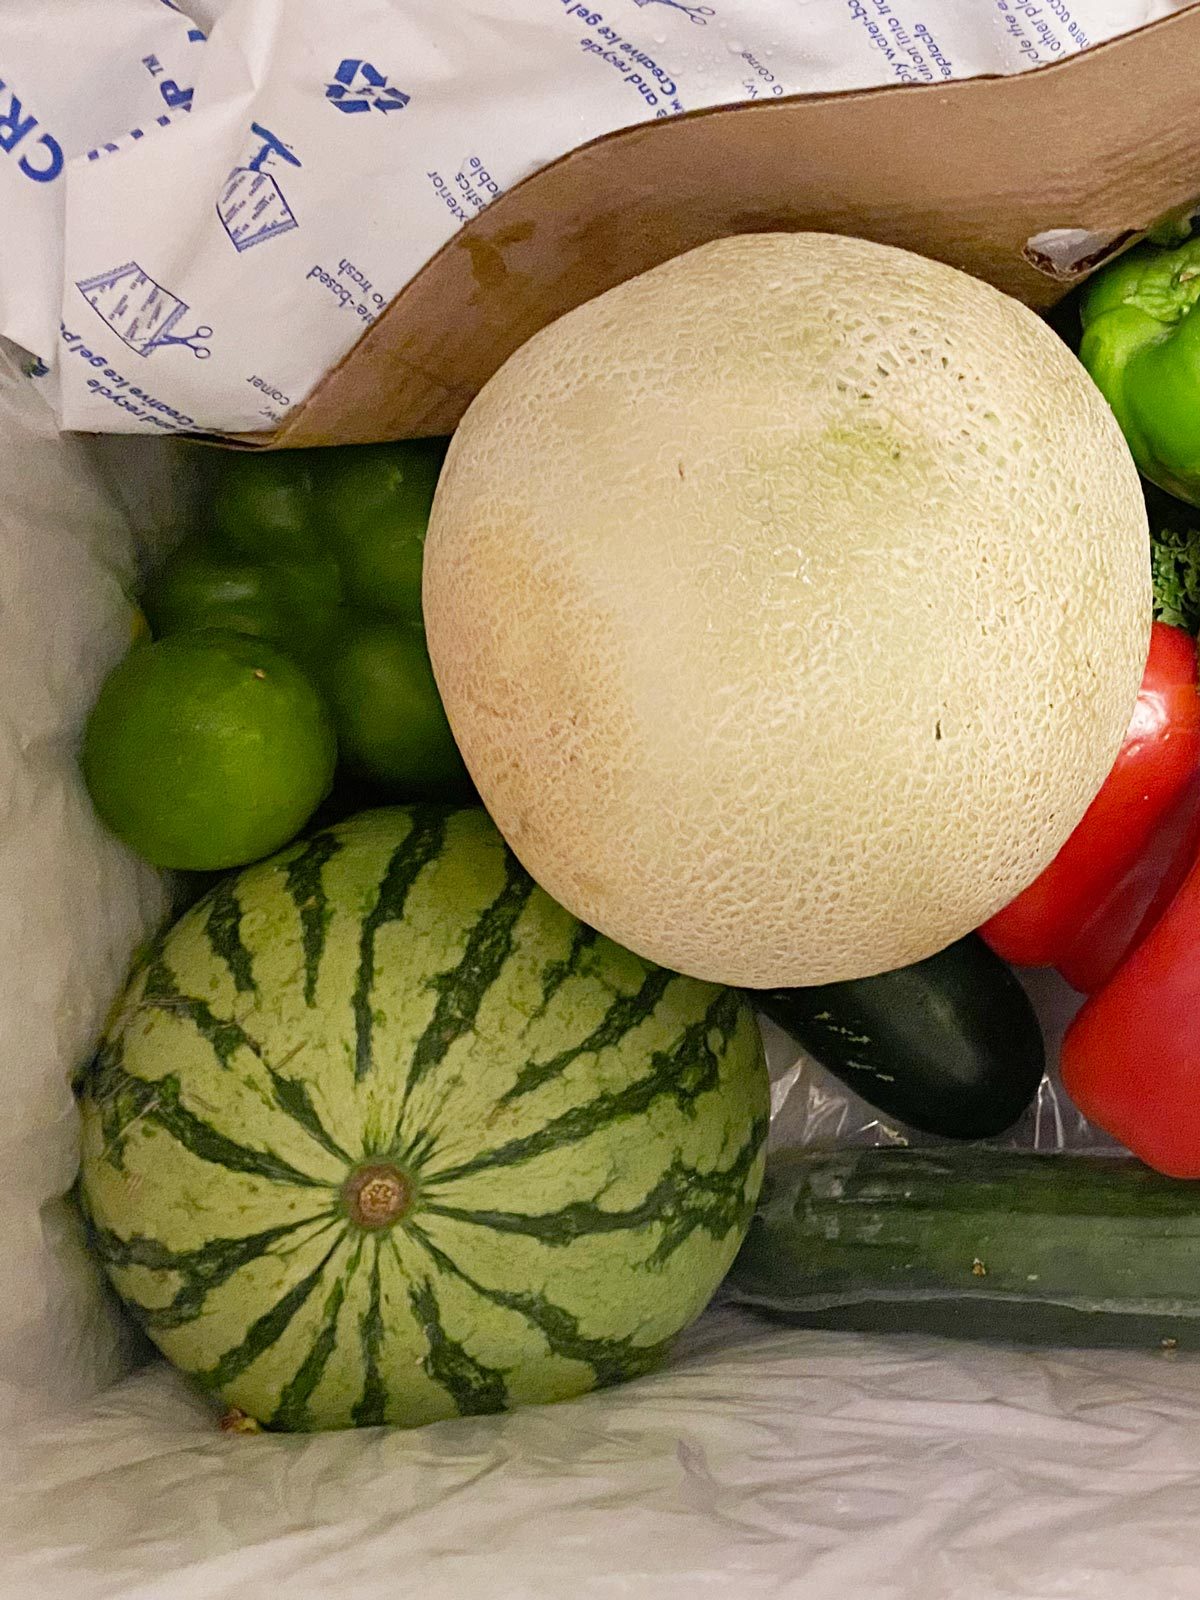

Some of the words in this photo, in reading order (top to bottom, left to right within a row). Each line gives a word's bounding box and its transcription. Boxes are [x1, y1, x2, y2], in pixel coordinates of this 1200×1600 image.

[566, 2, 603, 26] gel
[1005, 14, 1025, 37] the
[597, 25, 622, 46] Ice
[888, 17, 911, 46] into
[1031, 19, 1061, 52] other
[580, 37, 631, 73] recycle
[914, 23, 952, 80] eptacle
[620, 42, 677, 96] Creative
[624, 73, 658, 106] and
[427, 171, 471, 222] xterior
[337, 258, 373, 293] trash
[69, 344, 108, 367] gel
[103, 368, 130, 388] Ice
[86, 379, 147, 422] recycle
[129, 386, 194, 425] Creative
